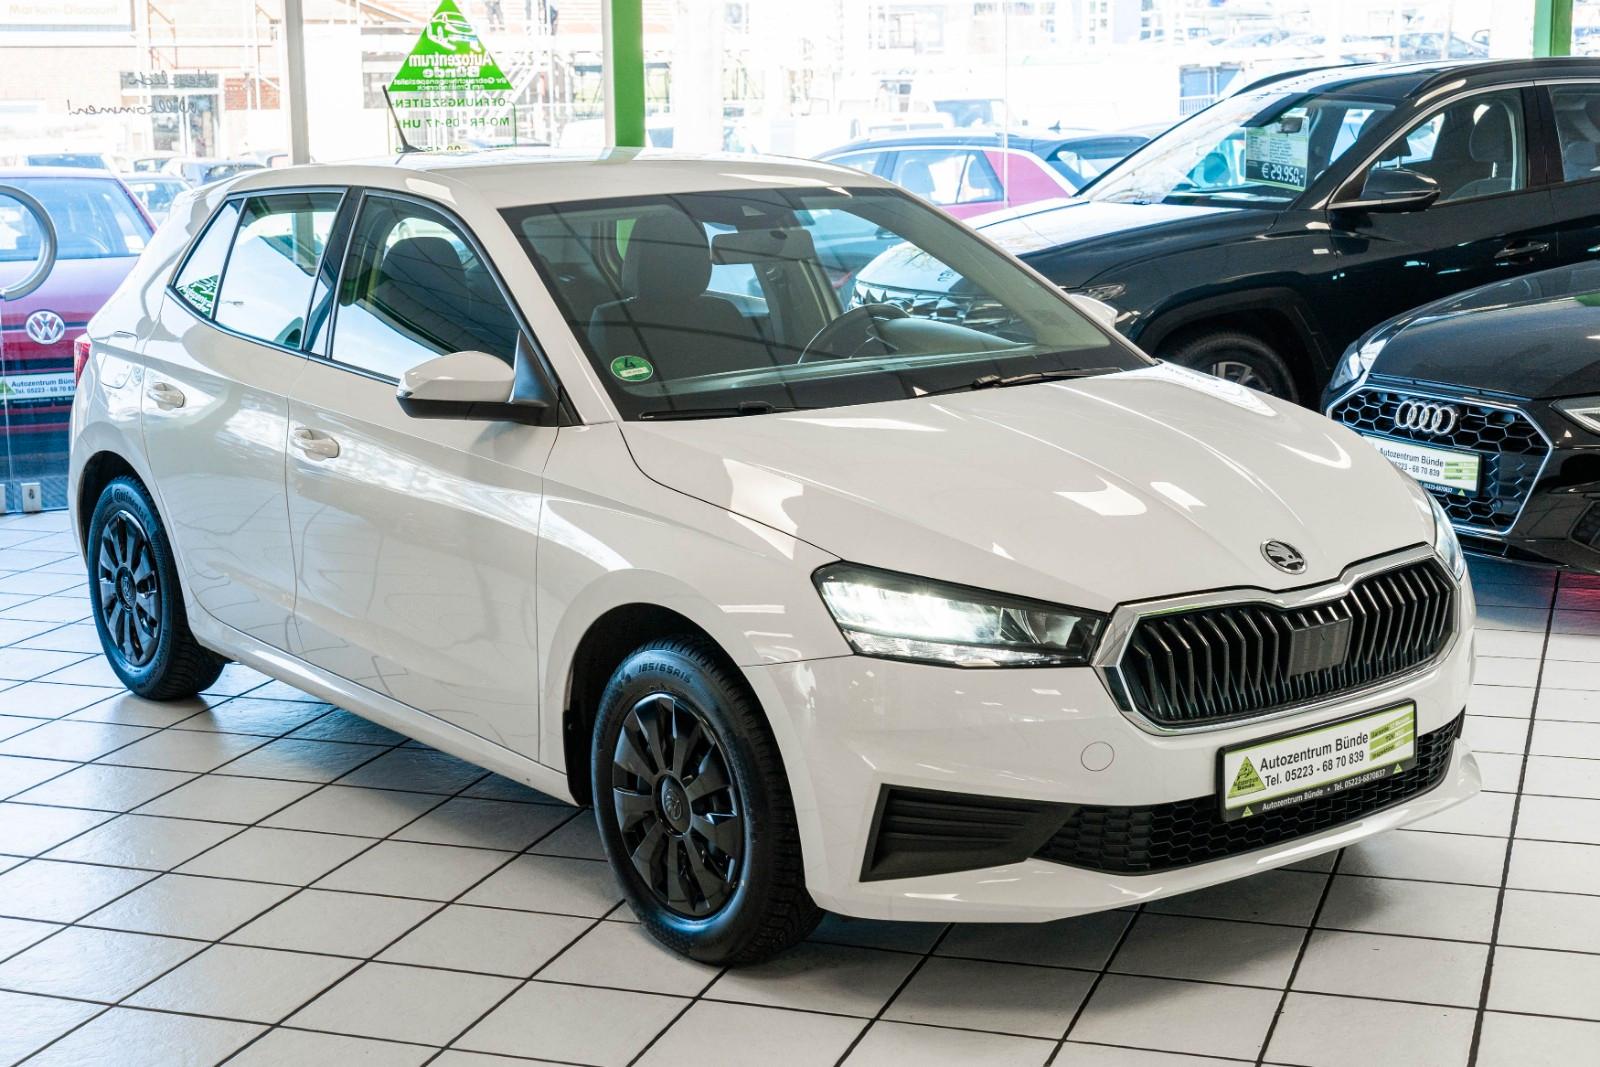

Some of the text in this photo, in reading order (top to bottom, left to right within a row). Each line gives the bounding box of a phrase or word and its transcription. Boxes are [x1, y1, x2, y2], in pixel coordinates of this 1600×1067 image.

[1421, 455, 1444, 468] Bünde
[638, 662, 691, 684] 185/65R15
[1260, 744, 1332, 772] Autozentrum
[1335, 732, 1369, 752] Bünde
[1265, 773, 1283, 787] Tel.
[1285, 766, 1314, 782] 05223
[1322, 761, 1333, 775] 68
[1336, 757, 1347, 771] 70
[1348, 751, 1365, 767] 839
[1262, 795, 1303, 811] Autozentrum
[1304, 789, 1324, 801] Bünde
[1334, 782, 1344, 792] Tel.
